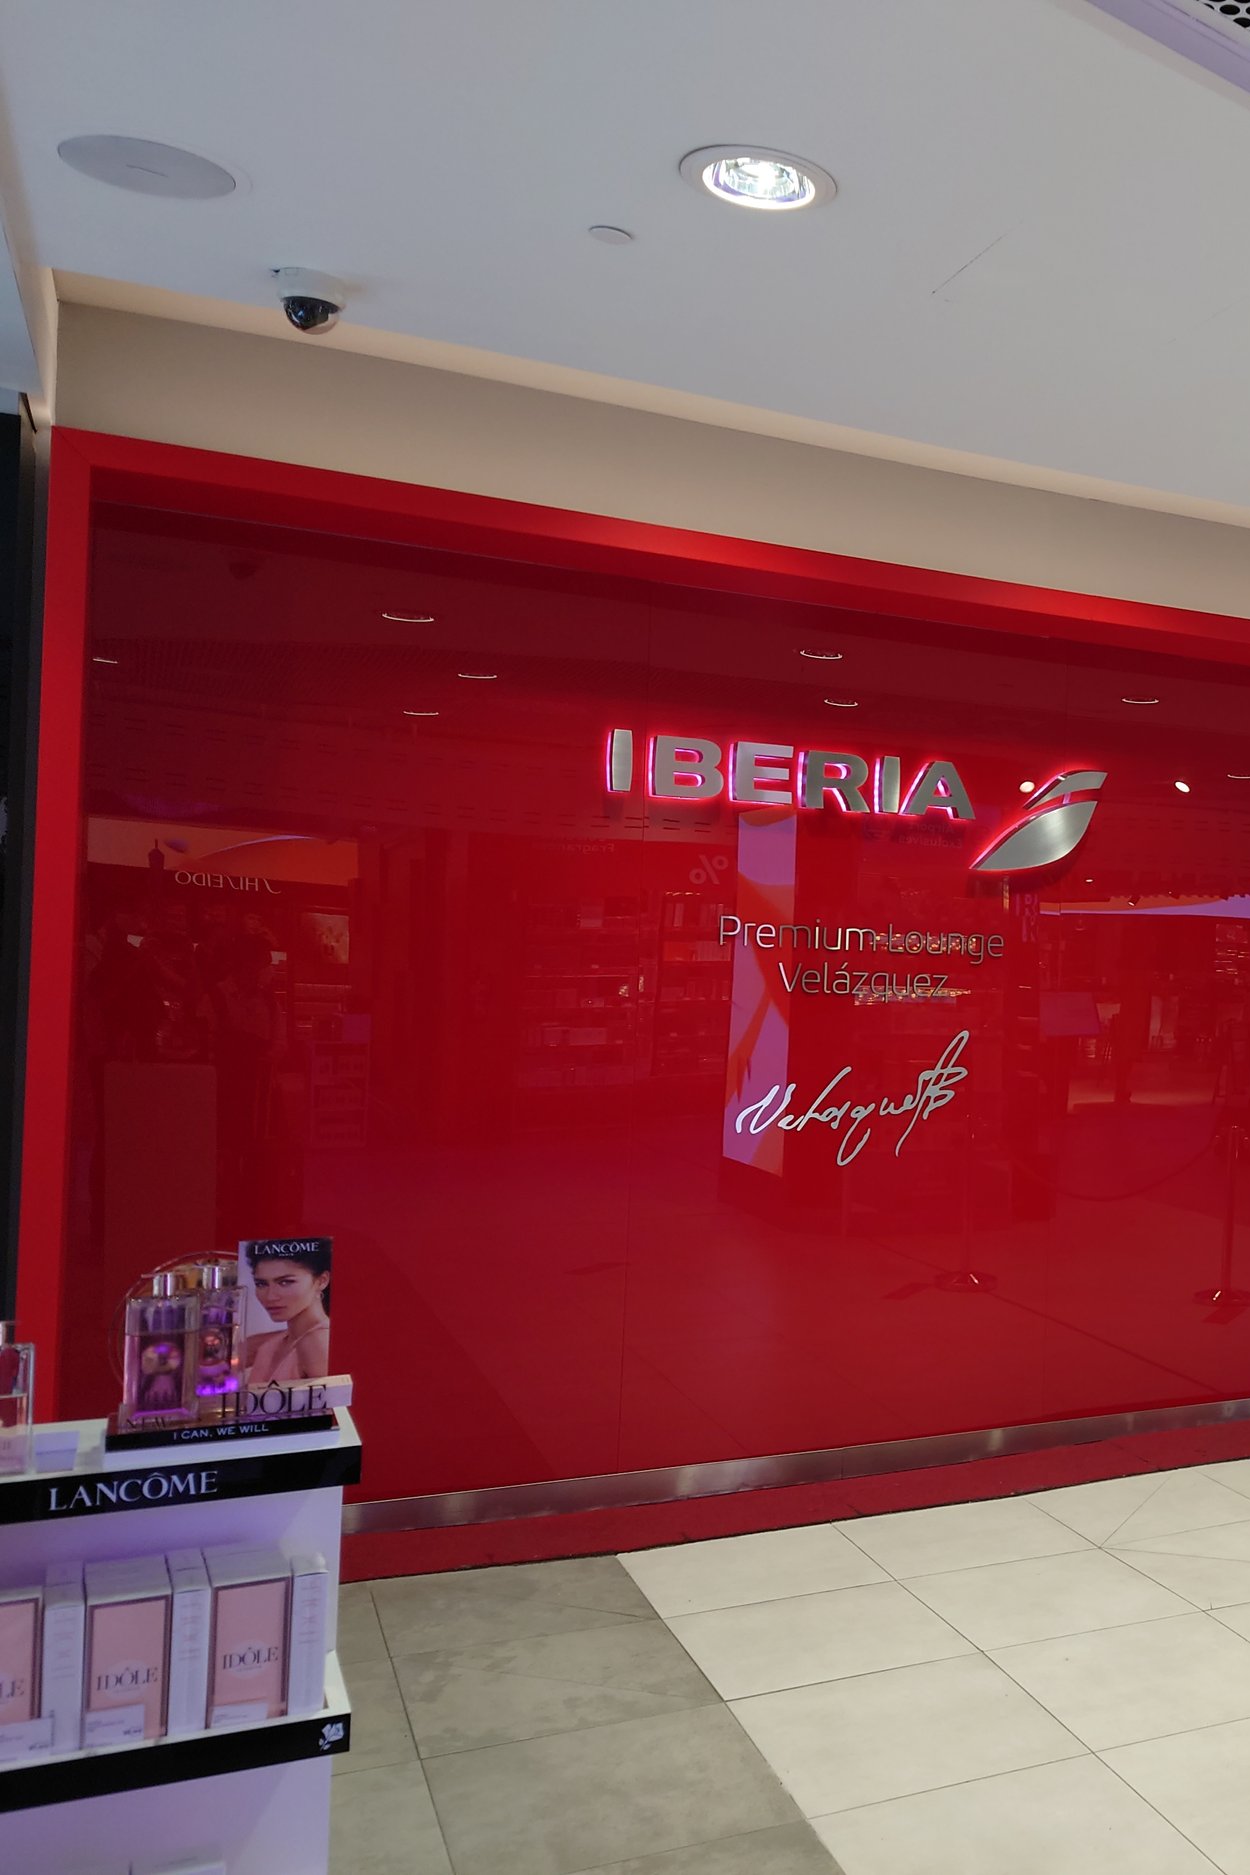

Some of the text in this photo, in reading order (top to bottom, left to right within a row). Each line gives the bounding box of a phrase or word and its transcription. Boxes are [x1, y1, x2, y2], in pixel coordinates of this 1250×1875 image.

[606, 728, 975, 820] IBERIA
[719, 915, 1004, 964] Premium Lounge
[778, 962, 949, 1003] Velázquez
[254, 1241, 320, 1255] LANCÔME
[220, 1379, 328, 1419] IDÔLE
[216, 1426, 236, 1435] WE
[239, 1423, 269, 1433] WILL
[49, 1470, 219, 1511] LANCÔME
[222, 1646, 279, 1671] IDÔLE
[96, 1667, 158, 1691] IDÔLE
